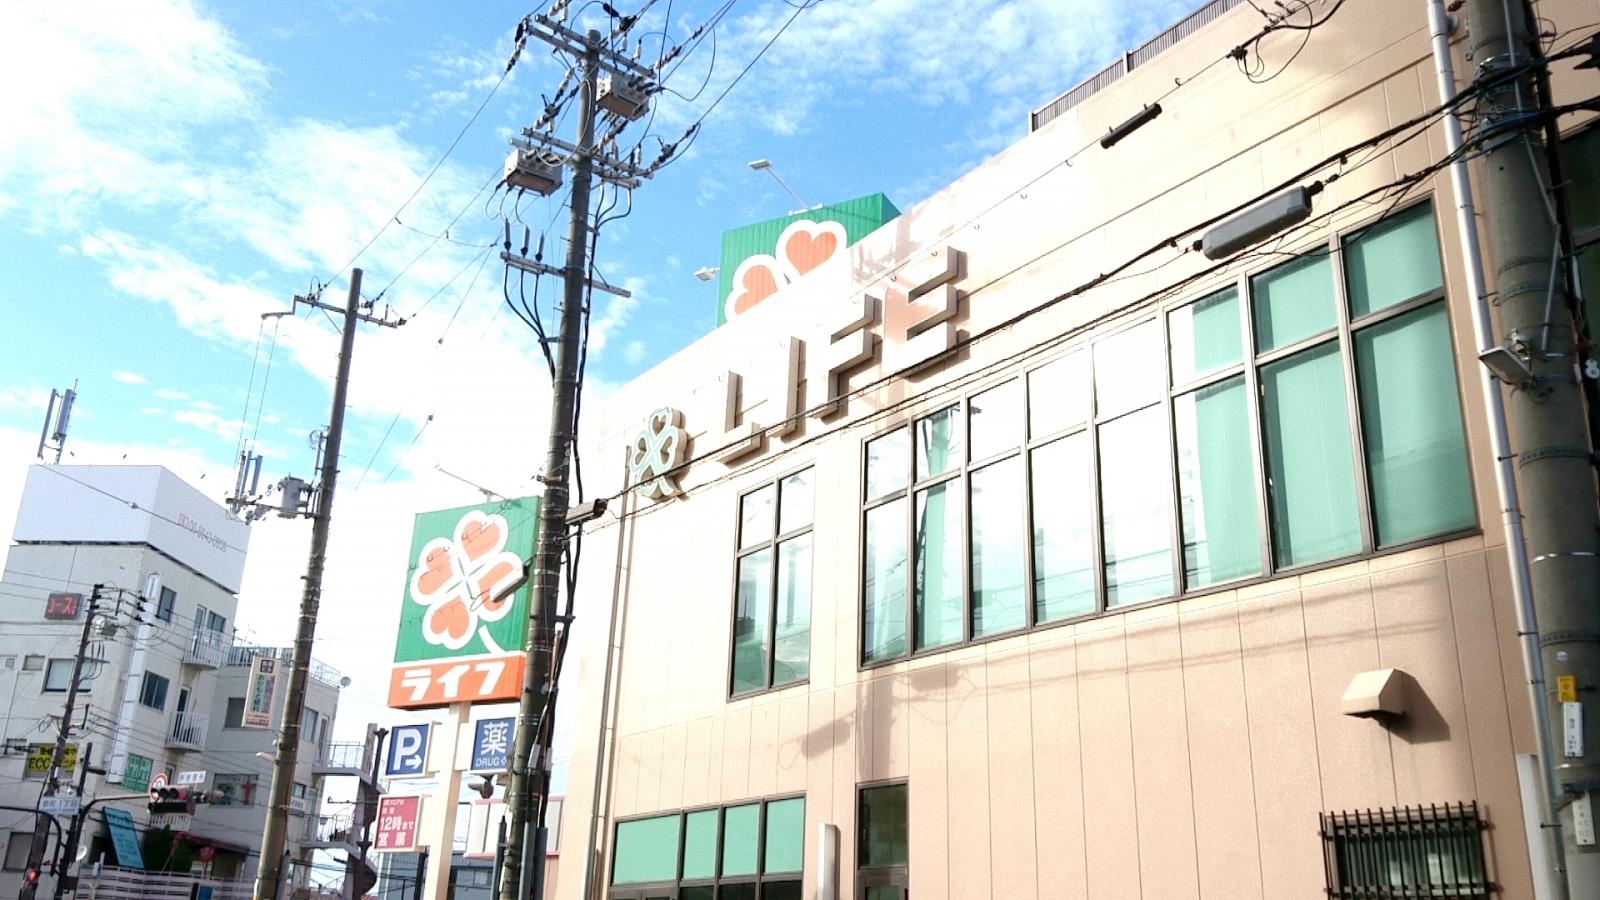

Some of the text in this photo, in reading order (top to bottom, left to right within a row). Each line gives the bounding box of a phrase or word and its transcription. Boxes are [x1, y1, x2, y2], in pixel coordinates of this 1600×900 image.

[709, 245, 959, 464] LIFE
[401, 661, 506, 702] ライフ
[392, 728, 422, 771] P
[481, 722, 508, 756] 薬
[28, 757, 51, 769] ECC
[475, 756, 500, 767] DRUG
